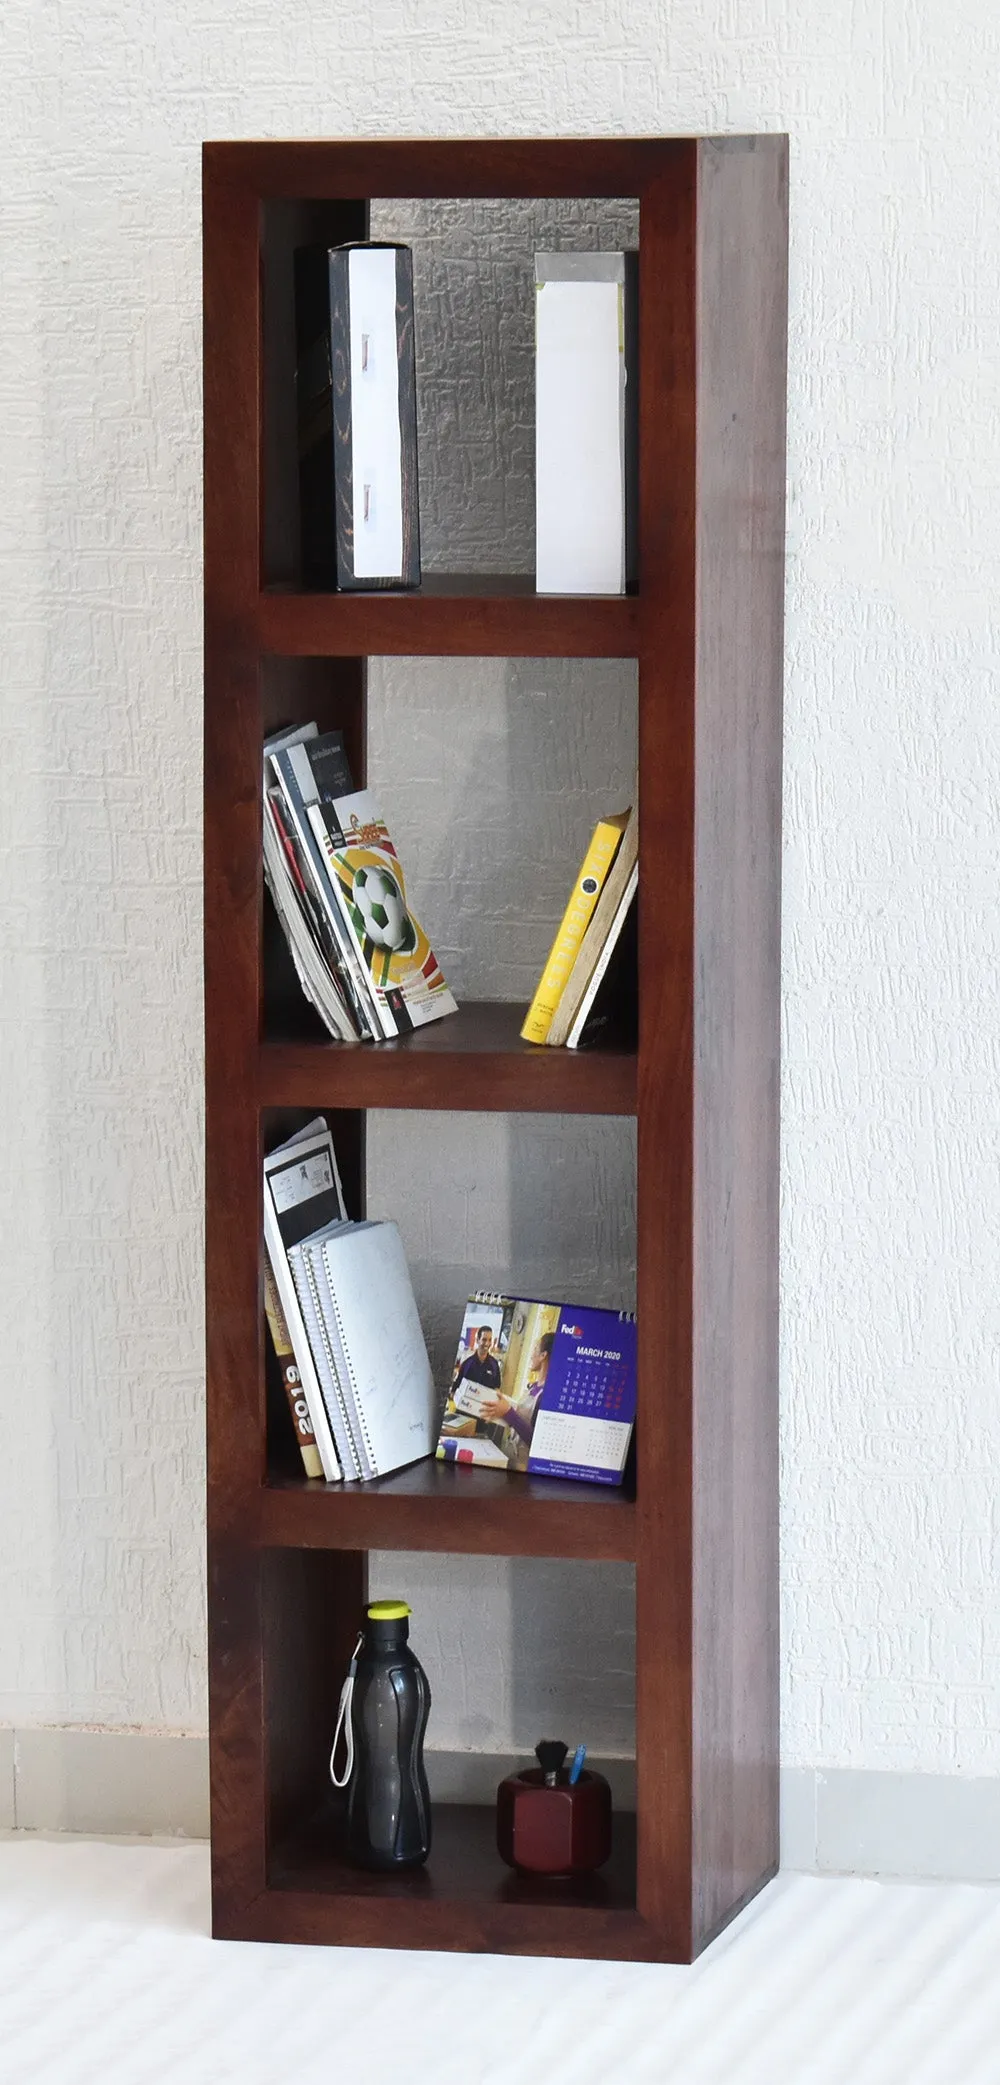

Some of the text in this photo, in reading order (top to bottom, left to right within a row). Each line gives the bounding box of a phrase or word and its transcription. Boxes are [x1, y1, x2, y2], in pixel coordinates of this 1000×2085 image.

[576, 1346, 621, 1361] MARCH 2020
[286, 1365, 314, 1435] 2019
